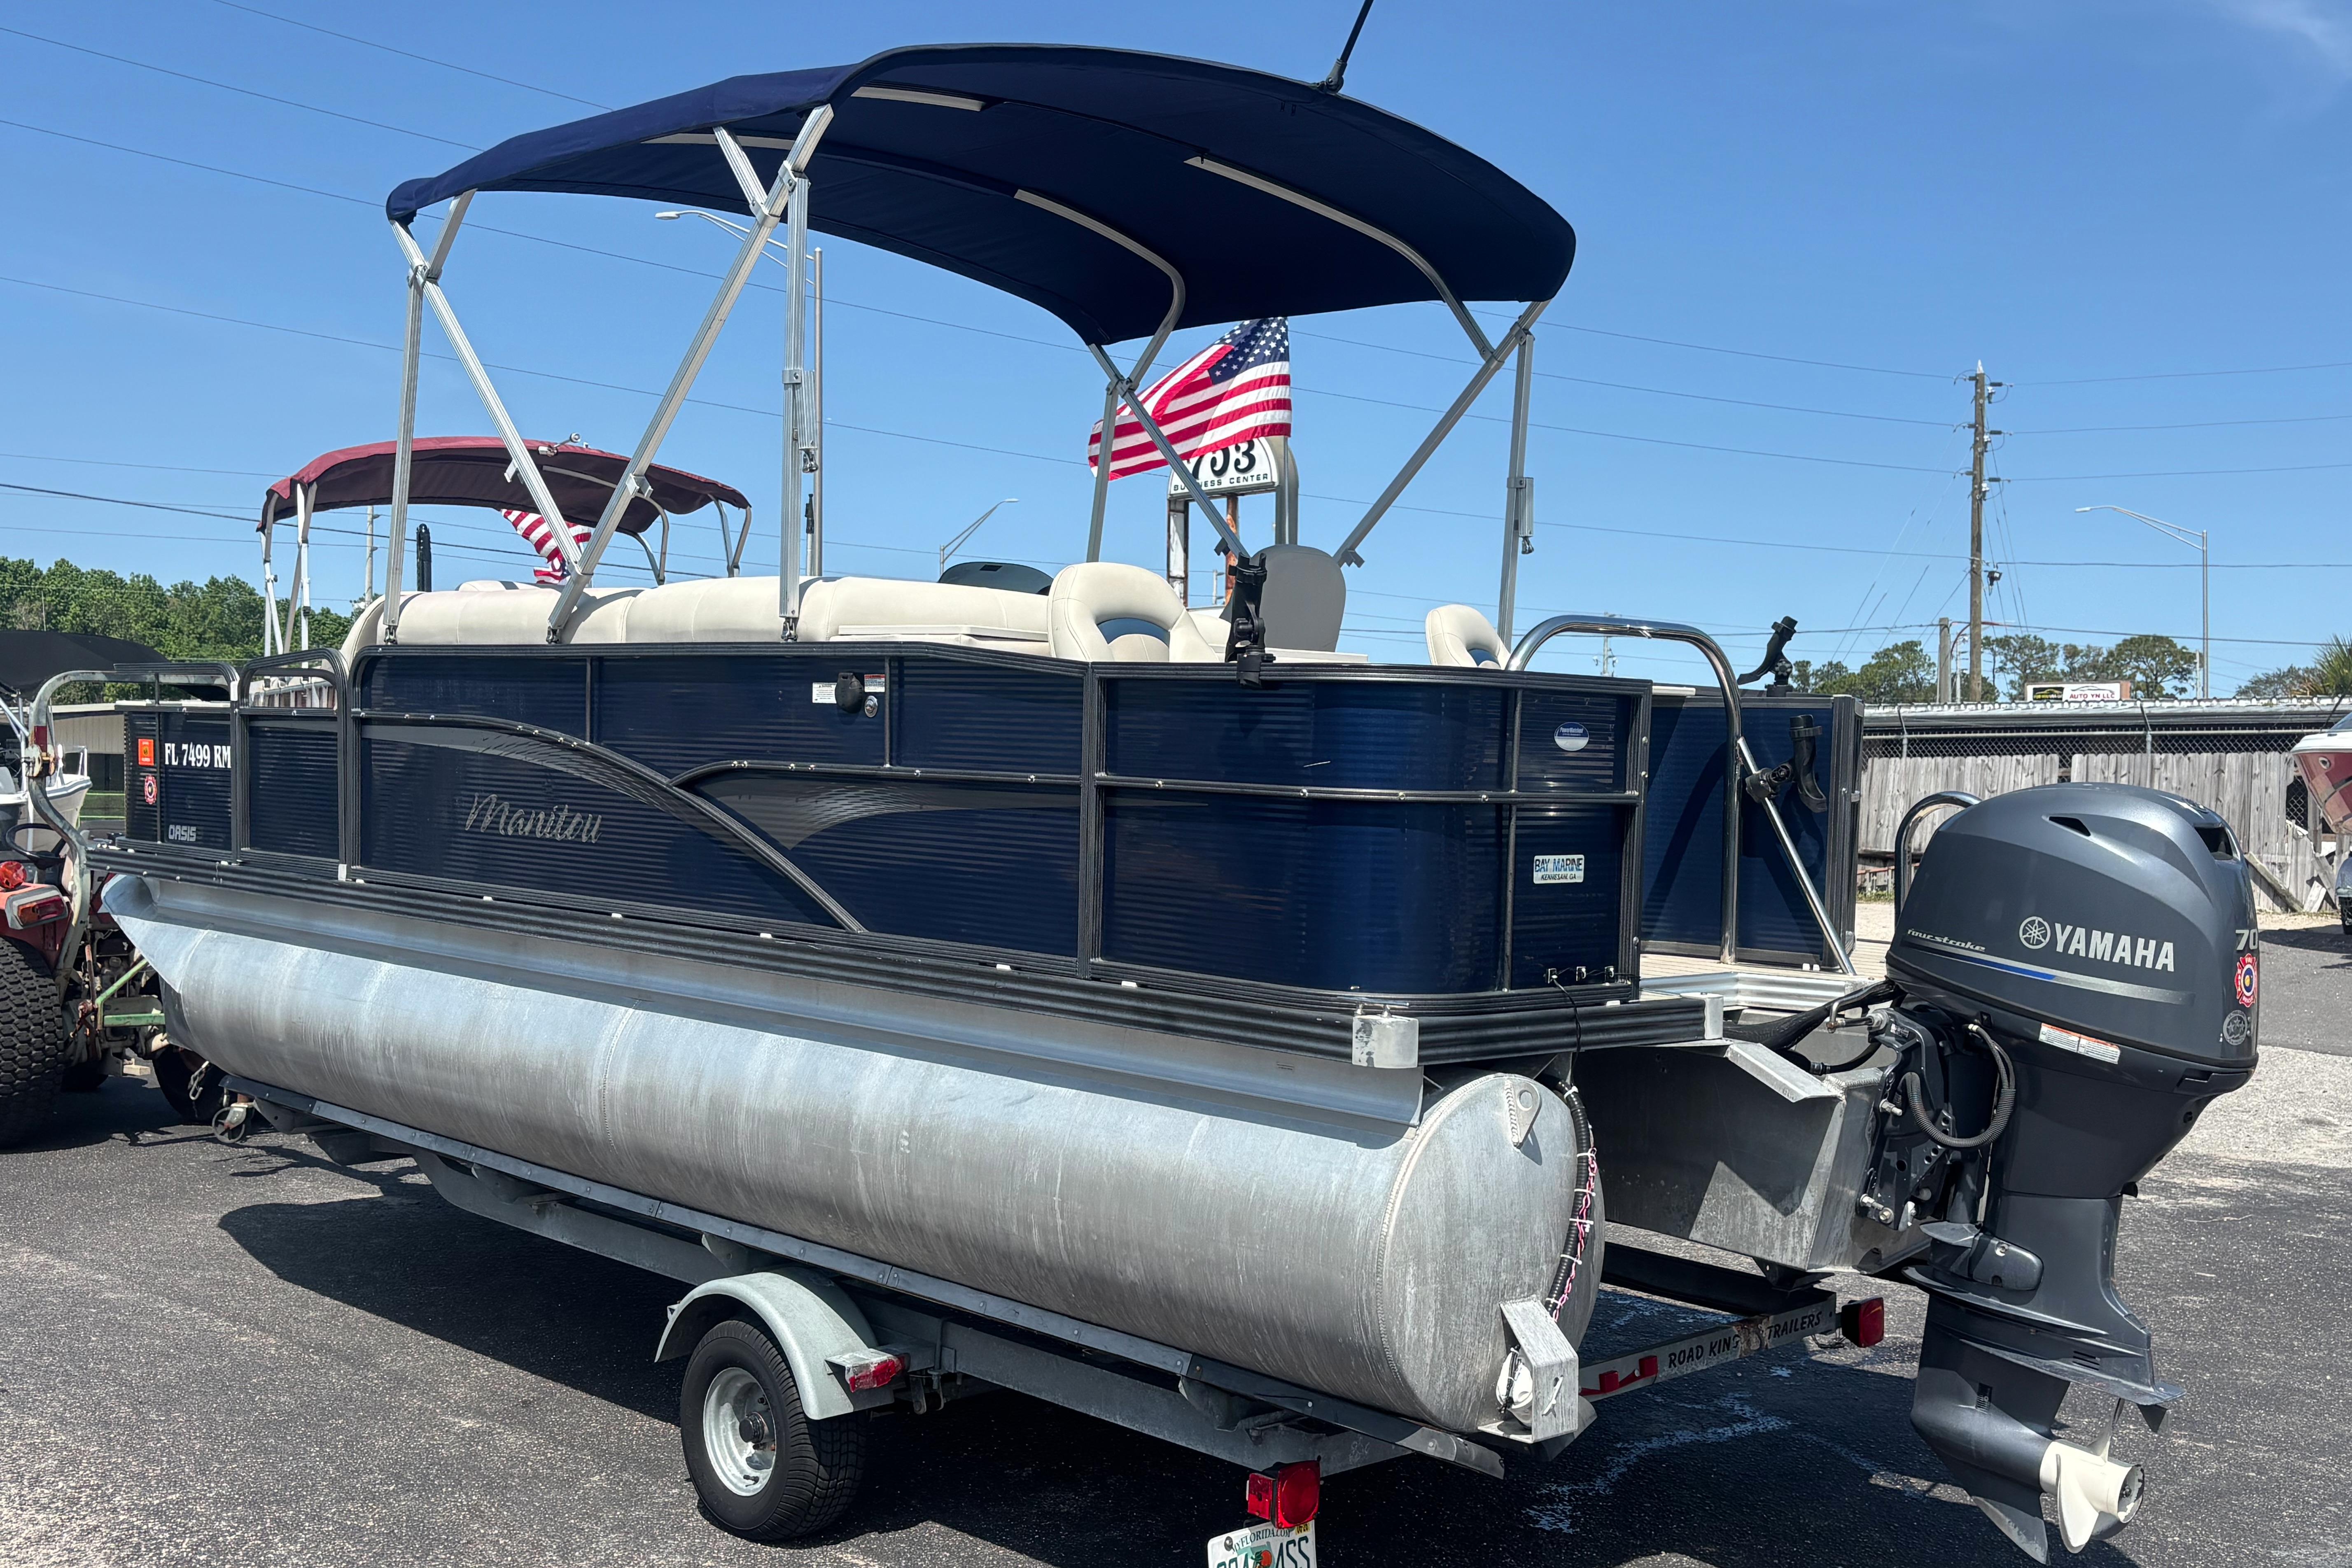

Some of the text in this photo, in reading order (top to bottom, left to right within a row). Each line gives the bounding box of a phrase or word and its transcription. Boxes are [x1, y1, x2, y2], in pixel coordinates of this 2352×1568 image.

[1229, 473, 1268, 484] CENTER
[165, 742, 232, 769] FL 7499 RM
[464, 792, 602, 844] Manitou
[168, 824, 197, 842] OASIS
[1535, 858, 1583, 873] BAY MARINE
[2055, 923, 2174, 972] YAMAHA
[2235, 929, 2259, 951] 70
[1668, 1311, 1822, 1369] ROAD KING TRAILERS
